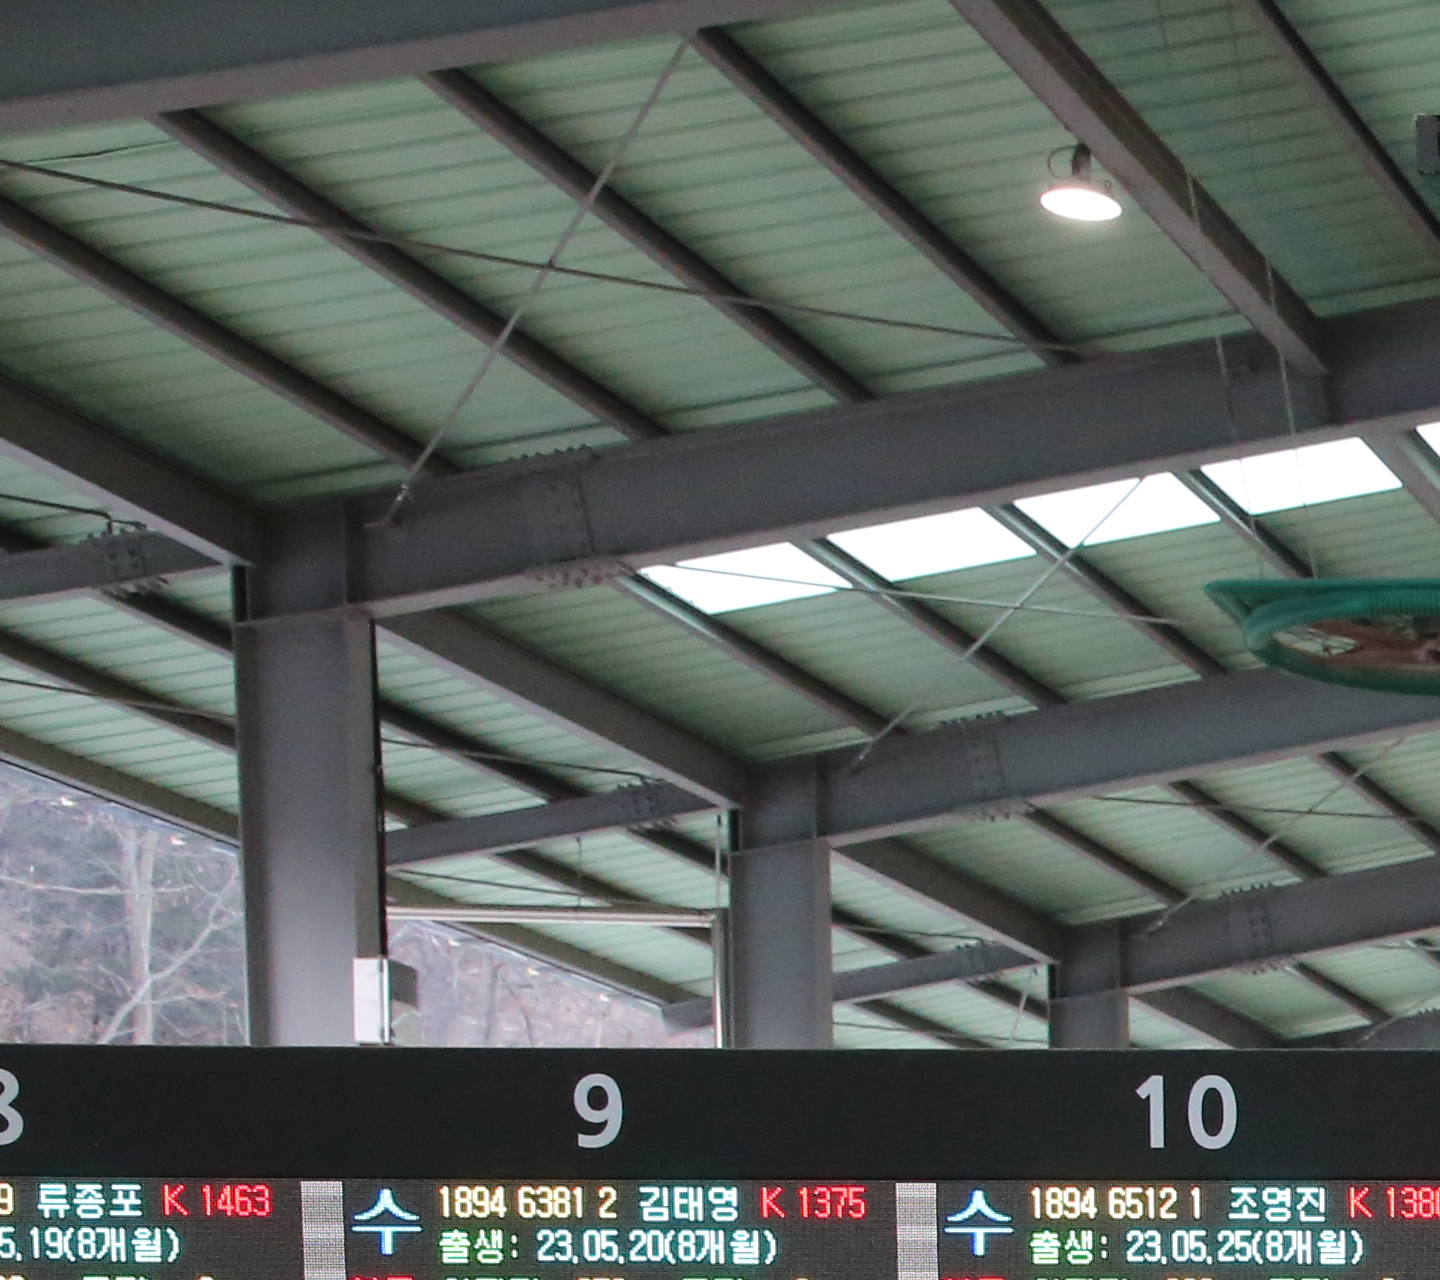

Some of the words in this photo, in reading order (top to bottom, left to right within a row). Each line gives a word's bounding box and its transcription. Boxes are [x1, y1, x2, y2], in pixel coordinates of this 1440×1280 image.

[573, 1073, 623, 1149] 9
[1135, 1074, 1238, 1150] 10
[37, 1183, 142, 1219] 류종포
[163, 1184, 191, 1216] K
[202, 1184, 273, 1217] 1463
[438, 1185, 508, 1218] 1894
[516, 1185, 583, 1219] 6381
[598, 1186, 617, 1219] 2
[639, 1186, 738, 1222] 김태영
[759, 1186, 786, 1219] K
[798, 1185, 866, 1219] 1375
[1030, 1186, 1098, 1219] 1894
[1107, 1186, 1178, 1219] 6512
[1190, 1186, 1201, 1219] 1
[1228, 1186, 1326, 1223] 조영진
[1348, 1186, 1373, 1218] K
[351, 1188, 423, 1256] 수
[943, 1189, 1014, 1256] 수
[439, 1229, 518, 1264] 출생:
[1030, 1230, 1107, 1265] 출생:
